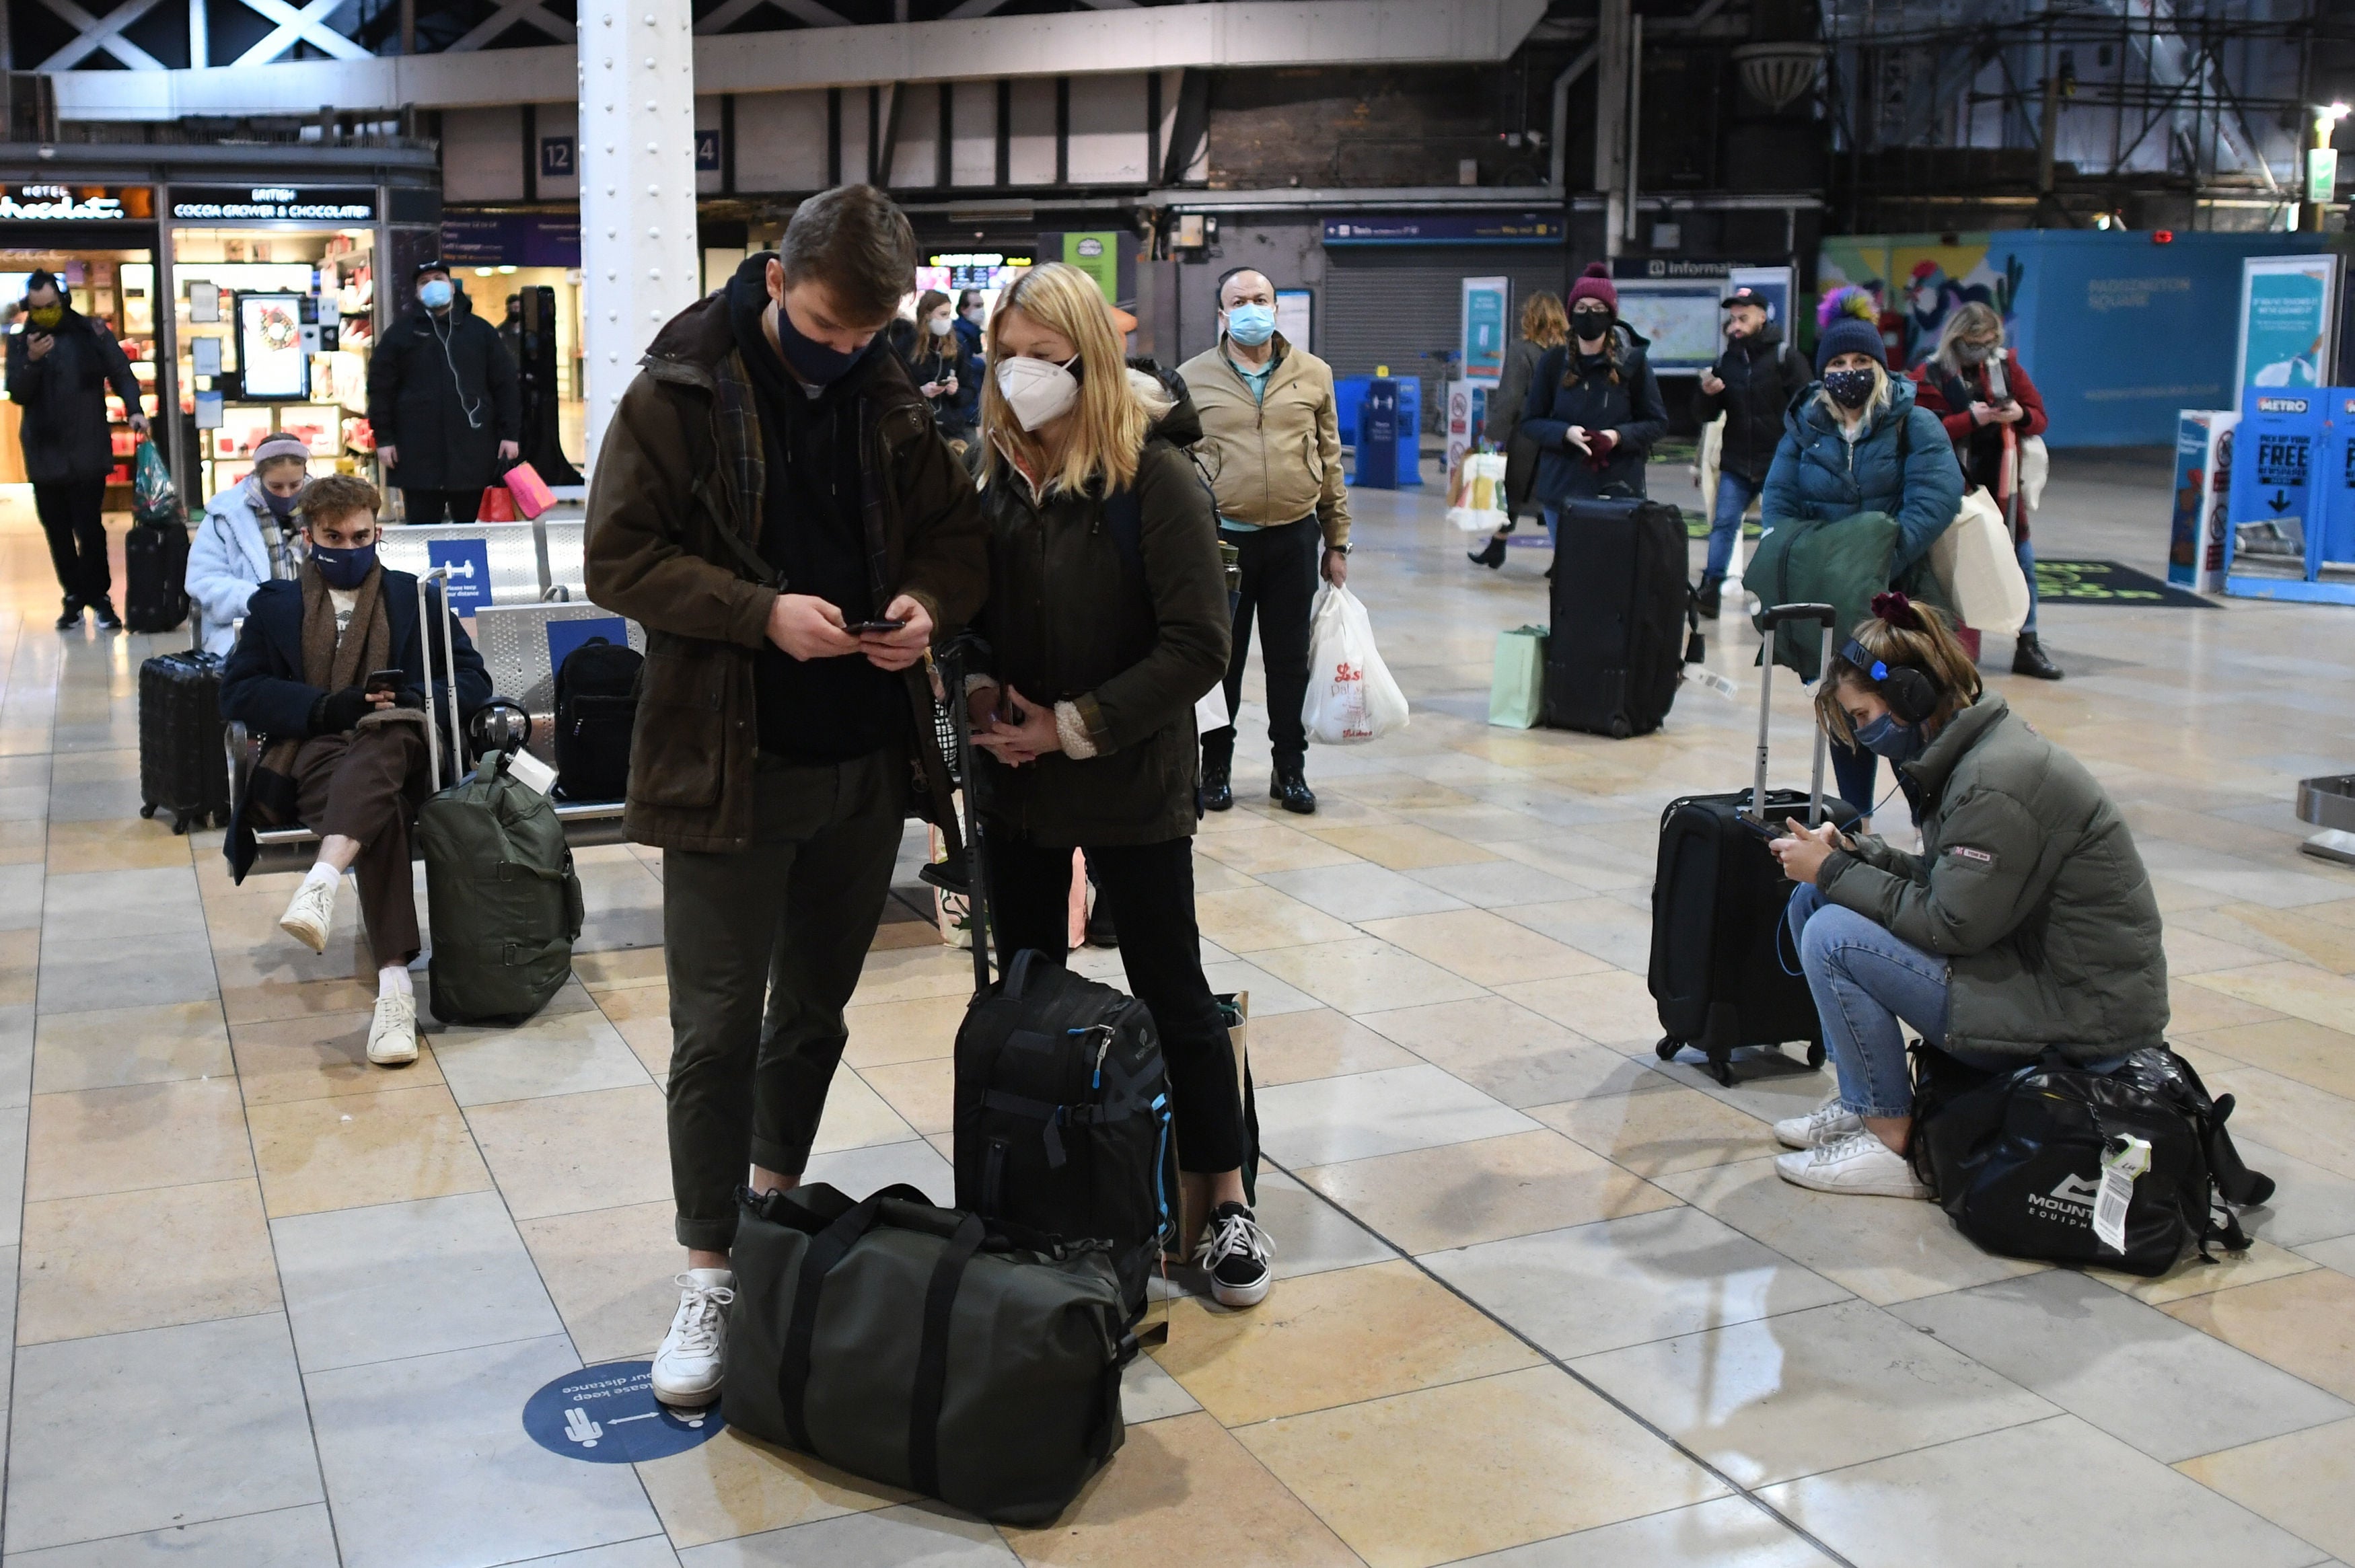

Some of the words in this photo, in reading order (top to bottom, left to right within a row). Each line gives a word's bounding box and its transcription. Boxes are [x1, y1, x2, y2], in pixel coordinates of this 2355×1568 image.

[546, 144, 569, 167] 12
[22, 185, 69, 198] HOTEL
[252, 188, 297, 202] BRITISH
[0, 196, 124, 219] hocolat.
[174, 204, 221, 219] COCOA
[222, 204, 276, 219] GROWER
[289, 204, 371, 219] CHOCOLATIER
[2260, 400, 2307, 412] METRO
[2259, 445, 2309, 467] FREE
[2028, 1193, 2094, 1220] MOUNT
[2029, 1207, 2096, 1230] EQUIPM
[630, 1373, 653, 1382] our
[562, 1377, 626, 1394] distance
[614, 1382, 654, 1394] lease
[573, 1390, 612, 1402] keep
